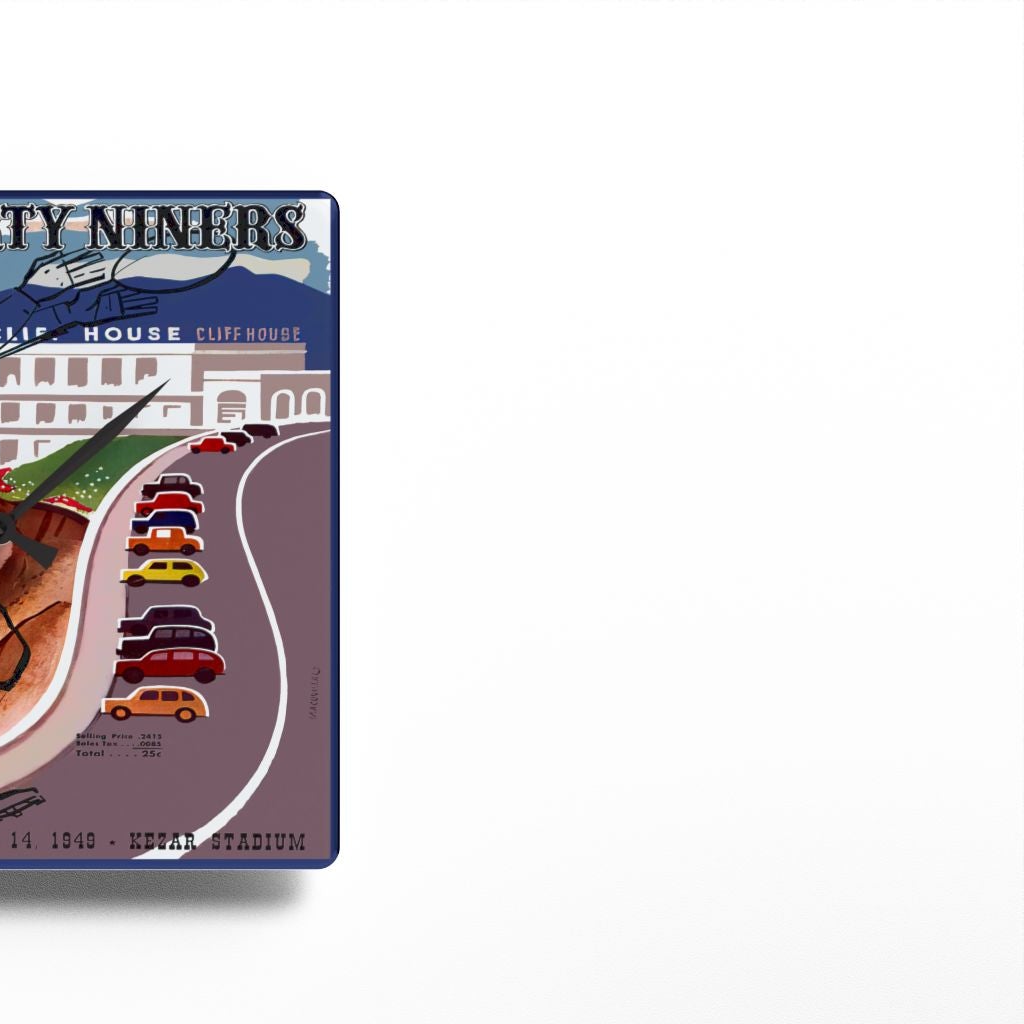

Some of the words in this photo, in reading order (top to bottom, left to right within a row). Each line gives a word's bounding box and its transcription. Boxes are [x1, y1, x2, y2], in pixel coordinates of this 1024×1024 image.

[85, 201, 307, 253] NINERS
[84, 326, 181, 341] HOUSE
[196, 327, 241, 341] CLIFF
[247, 326, 300, 341] HOUSE
[76, 749, 105, 757] Total
[51, 831, 96, 849] 1949
[129, 832, 197, 851] KEZAR
[211, 833, 306, 851] STADIUM
